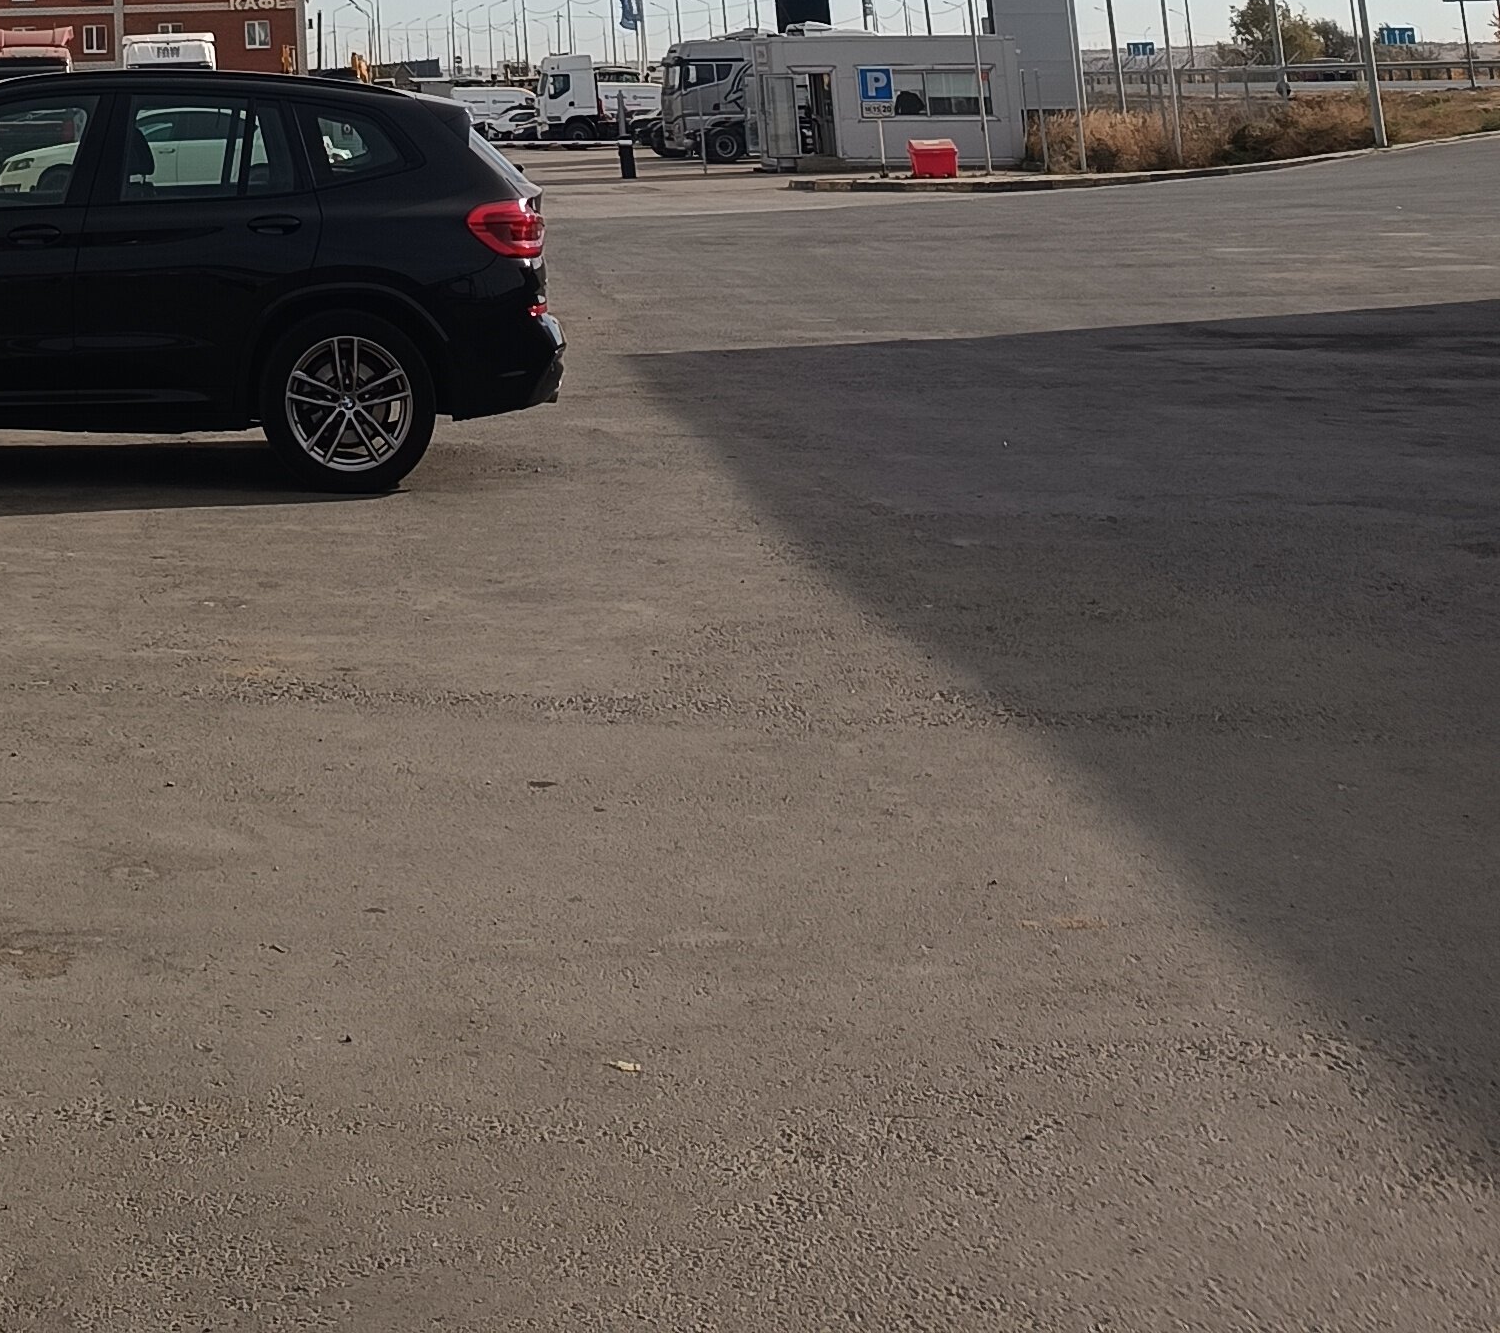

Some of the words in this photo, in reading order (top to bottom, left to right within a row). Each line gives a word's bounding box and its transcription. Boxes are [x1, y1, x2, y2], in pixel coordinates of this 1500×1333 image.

[156, 46, 180, 58] FAW
[866, 71, 888, 97] P
[881, 105, 892, 113] 20
